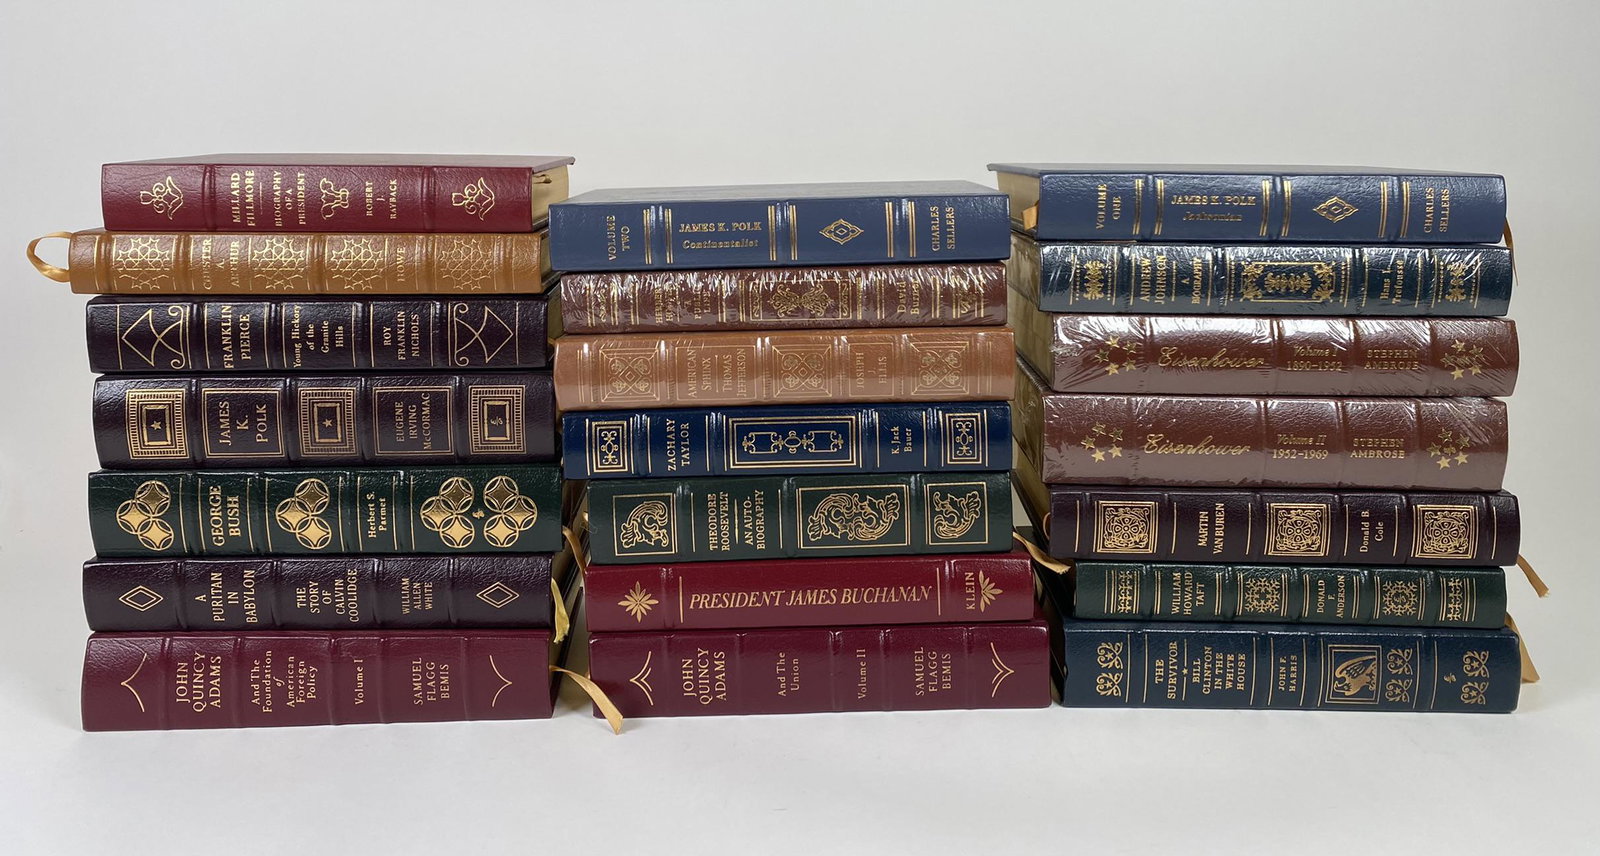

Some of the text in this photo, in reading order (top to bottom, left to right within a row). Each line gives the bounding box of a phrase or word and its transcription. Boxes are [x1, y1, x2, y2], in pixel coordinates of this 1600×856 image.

[231, 172, 241, 223] MILLARD
[245, 169, 256, 227] FILLMORE
[273, 170, 283, 227] BIOGRAPHY
[285, 188, 293, 210] OF A
[297, 172, 306, 225] PRESIDENT
[365, 181, 373, 216] ROBERT
[389, 179, 398, 219] RAYBACK
[1096, 183, 1108, 230] VOLUME
[1112, 196, 1122, 220] ONE
[1171, 195, 1256, 206] JAMES K. POLK
[1424, 187, 1435, 233] CHARLES
[1439, 189, 1450, 232] SELLERS
[606, 215, 617, 261] VOLUME
[620, 225, 631, 251] TWO
[679, 221, 762, 233] JAMES K. POLK
[682, 239, 759, 250] Continentalist
[930, 206, 940, 252] CHARLES
[945, 206, 955, 250] SELLERS
[202, 239, 212, 290] CHESTER
[229, 240, 240, 288] ARTHUR
[397, 247, 406, 281] HOWE
[1140, 257, 1151, 302] ANDREW
[1155, 255, 1167, 305] JOHNSON
[1192, 257, 1202, 304] BIOGRAPHY
[1392, 259, 1404, 304] Trefousse
[655, 283, 663, 323] HERBER
[897, 281, 906, 313] David
[1380, 279, 1390, 299] Hans
[220, 305, 234, 369] FRANKLIN
[240, 314, 251, 360] PIERCE
[290, 305, 303, 368] Young Hickory
[306, 323, 315, 351] of the
[321, 320, 329, 353] Granite
[335, 325, 344, 348] Hills
[383, 326, 393, 346] ROY
[397, 311, 407, 360] FRANKLIN
[411, 314, 420, 357] NICHOLS
[1293, 345, 1338, 357] Volume I
[1367, 349, 1418, 359] STEPHEN
[687, 349, 697, 398] AMERICAN
[701, 357, 711, 391] SPHINX
[723, 354, 732, 392] THOMAS
[737, 348, 747, 397] JEFFERSON
[856, 352, 864, 388] JOSEPH
[878, 356, 887, 384] ELLIS
[1158, 346, 1264, 368] Eisenhower
[1364, 361, 1419, 371] AMBROSE
[219, 400, 232, 446] JAMES
[236, 414, 249, 431] K.
[256, 403, 268, 443] POLK
[395, 401, 405, 442] EUGENE
[408, 404, 418, 439] IRVING
[421, 392, 433, 450] McCORMAC
[890, 425, 900, 455] K. Jack
[904, 428, 913, 452] Bauer
[1277, 434, 1327, 446] Volume II
[666, 418, 677, 472] ZACHARY
[680, 422, 690, 467] TAYLOR
[1143, 433, 1250, 455] Eisenhower
[1350, 450, 1406, 460] AMBROSE
[1353, 438, 1405, 448] STEPHEN
[209, 485, 225, 547] GEORGE
[226, 495, 241, 537] BUSH
[366, 491, 377, 539] Herbert S.
[378, 498, 387, 532] Parmet
[707, 493, 718, 551] THEODORE
[720, 491, 731, 551] ROOSEVELT
[743, 496, 753, 546] AN AUTO-
[754, 489, 766, 550] BIOGRAPHY
[1197, 510, 1209, 547] MARTIN
[1213, 502, 1225, 555] VAN BUREN
[1359, 509, 1370, 553] Donald B.
[1375, 521, 1384, 542] Cole
[195, 594, 207, 602] A
[211, 572, 225, 622] PURITAN
[228, 591, 239, 604] IN
[243, 570, 258, 623] BABYLON
[296, 587, 307, 608] THE
[309, 581, 320, 614] STORY
[322, 589, 332, 605] OF
[335, 578, 345, 615] CALVIN
[347, 568, 360, 623] COOLIDGE
[401, 578, 411, 615] WILLIAM
[413, 581, 423, 611] ALLEN
[424, 581, 434, 610] WHITE
[689, 585, 932, 610] PRESIDENT JAMES BUCHANAN
[965, 572, 976, 610] KLEIN
[1171, 571, 1182, 615] WILLIAM
[1183, 571, 1193, 616] HOWARD
[1196, 582, 1206, 607] TAFT
[1316, 579, 1326, 613] DONALD
[1335, 575, 1345, 619] ANDERSON
[176, 662, 191, 704] JOHN
[193, 650, 206, 713] QUINCY
[209, 656, 222, 708] ADAMS
[251, 659, 261, 705] And The
[262, 650, 272, 713] Foundation
[273, 676, 285, 687] of
[286, 656, 295, 708] American
[296, 660, 308, 704] Foreign
[307, 665, 318, 699] Policy
[354, 667, 364, 705] Volume
[412, 657, 423, 705] SAMUEL
[426, 661, 436, 702] FLAGG
[439, 663, 450, 699] BEMIS
[681, 658, 697, 697] JOHN
[697, 647, 713, 705] QUINCY
[713, 651, 727, 701] ADAMS
[777, 652, 786, 697] And The
[791, 658, 800, 691] Union
[856, 648, 867, 700] Volume II
[914, 647, 925, 696] SAMUEL
[928, 651, 939, 692] FLAGG
[941, 653, 952, 690] BEMIS
[1155, 659, 1165, 684] THE
[1167, 641, 1178, 700] SURVIVOR
[1192, 658, 1201, 683] BILL
[1202, 646, 1213, 695] CLINTON
[1214, 652, 1223, 690] IN THE
[1225, 654, 1234, 690] WHITE
[1236, 654, 1246, 691] HOUSE
[1278, 665, 1286, 691] JOHN
[1289, 655, 1297, 692] HARRIS
